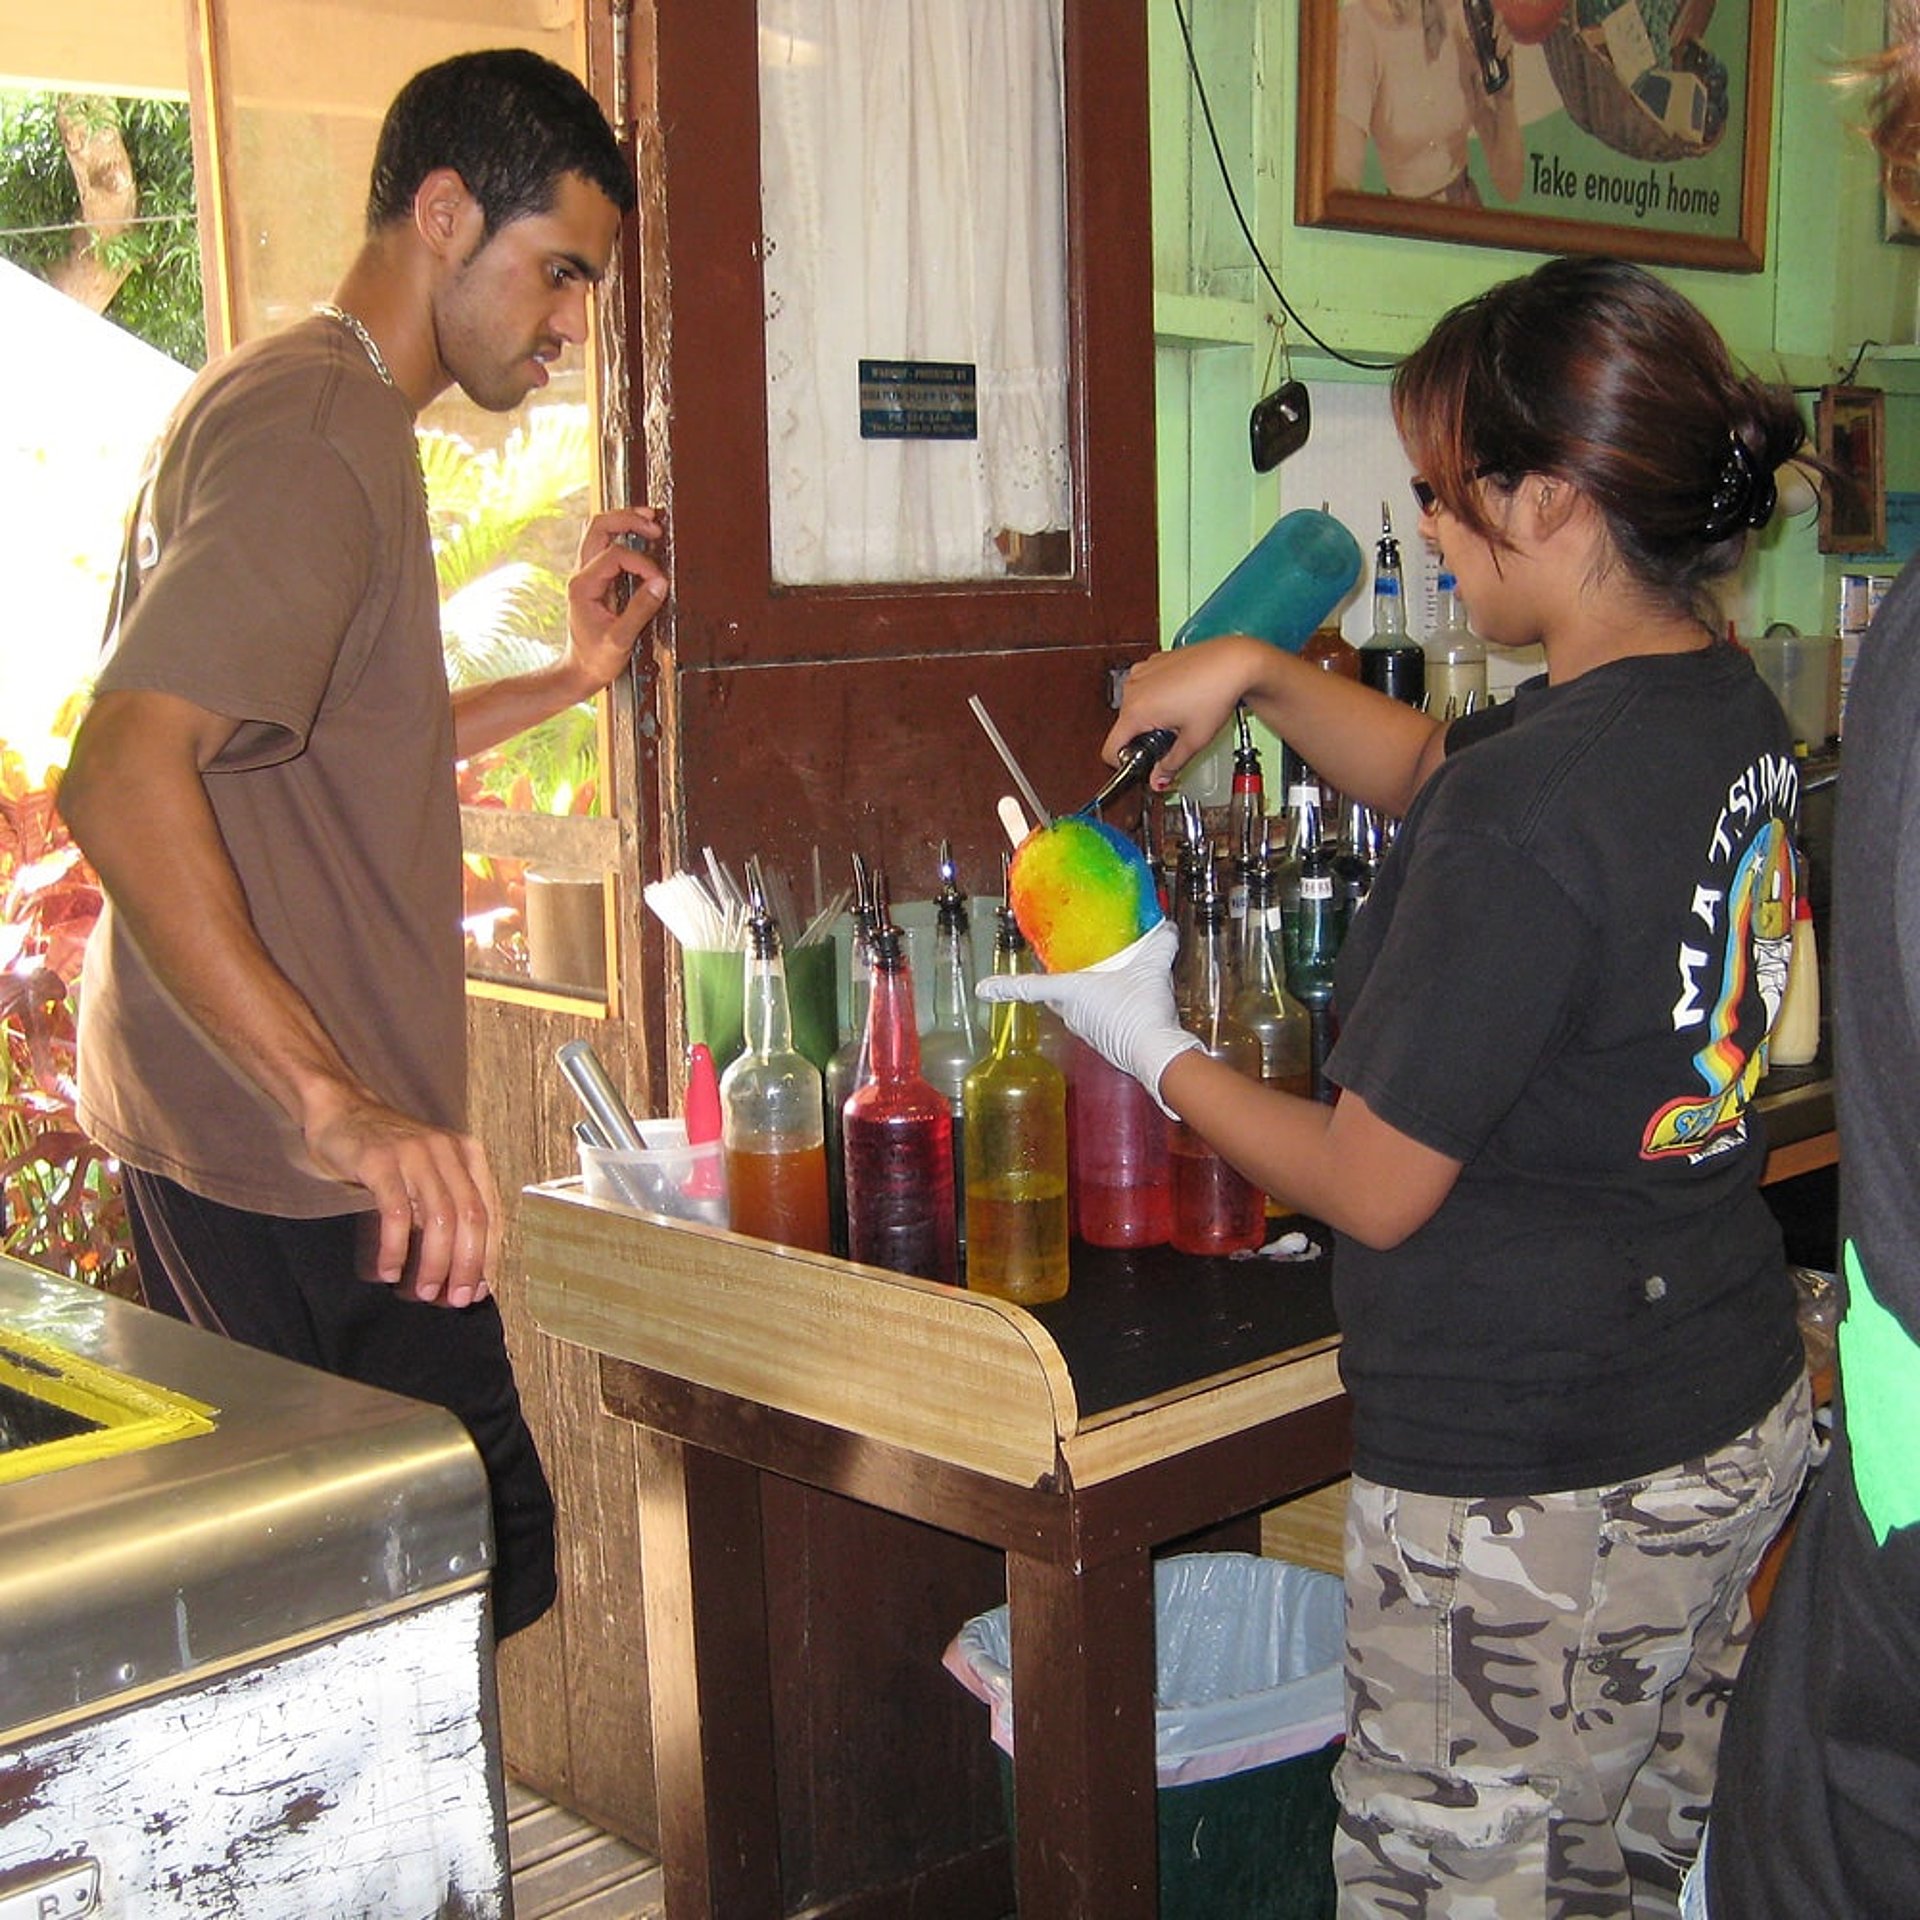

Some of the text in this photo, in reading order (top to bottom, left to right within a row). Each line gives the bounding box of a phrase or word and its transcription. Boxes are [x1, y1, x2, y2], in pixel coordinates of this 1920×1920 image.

[1530, 153, 1720, 218] Take enough home
